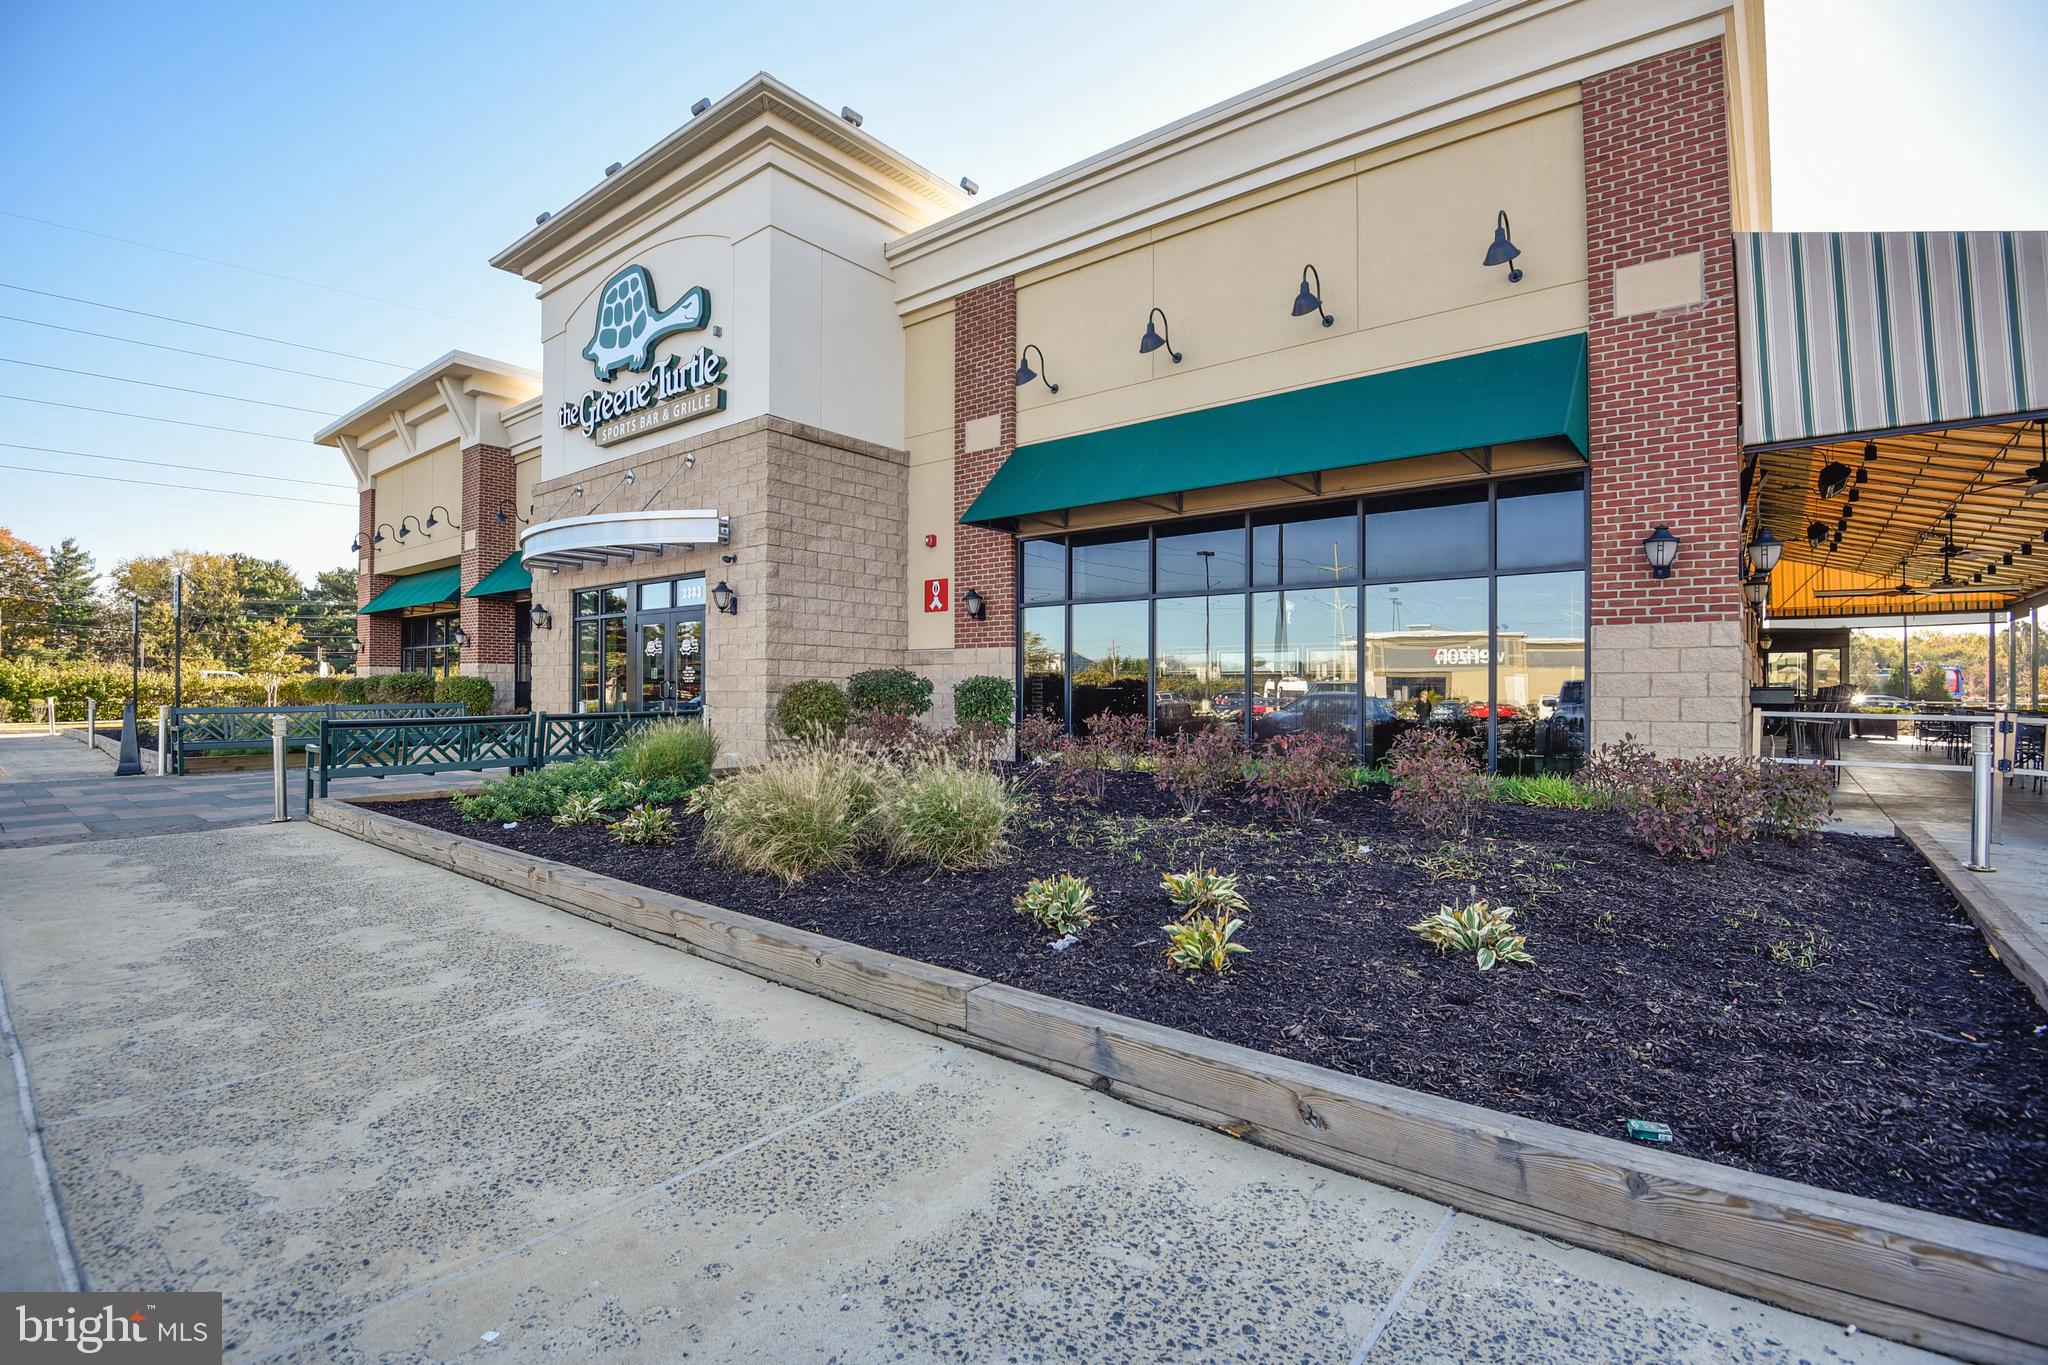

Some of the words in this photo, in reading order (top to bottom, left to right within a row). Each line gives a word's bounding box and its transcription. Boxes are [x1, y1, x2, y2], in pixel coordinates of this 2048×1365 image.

[558, 402, 580, 428] the
[579, 381, 651, 438] Greene
[650, 346, 721, 400] Turtle
[602, 420, 637, 442] SPORTS
[640, 412, 659, 429] BAR
[662, 408, 670, 422] &
[673, 393, 711, 418] GRILLE
[682, 586, 702, 599] 2383
